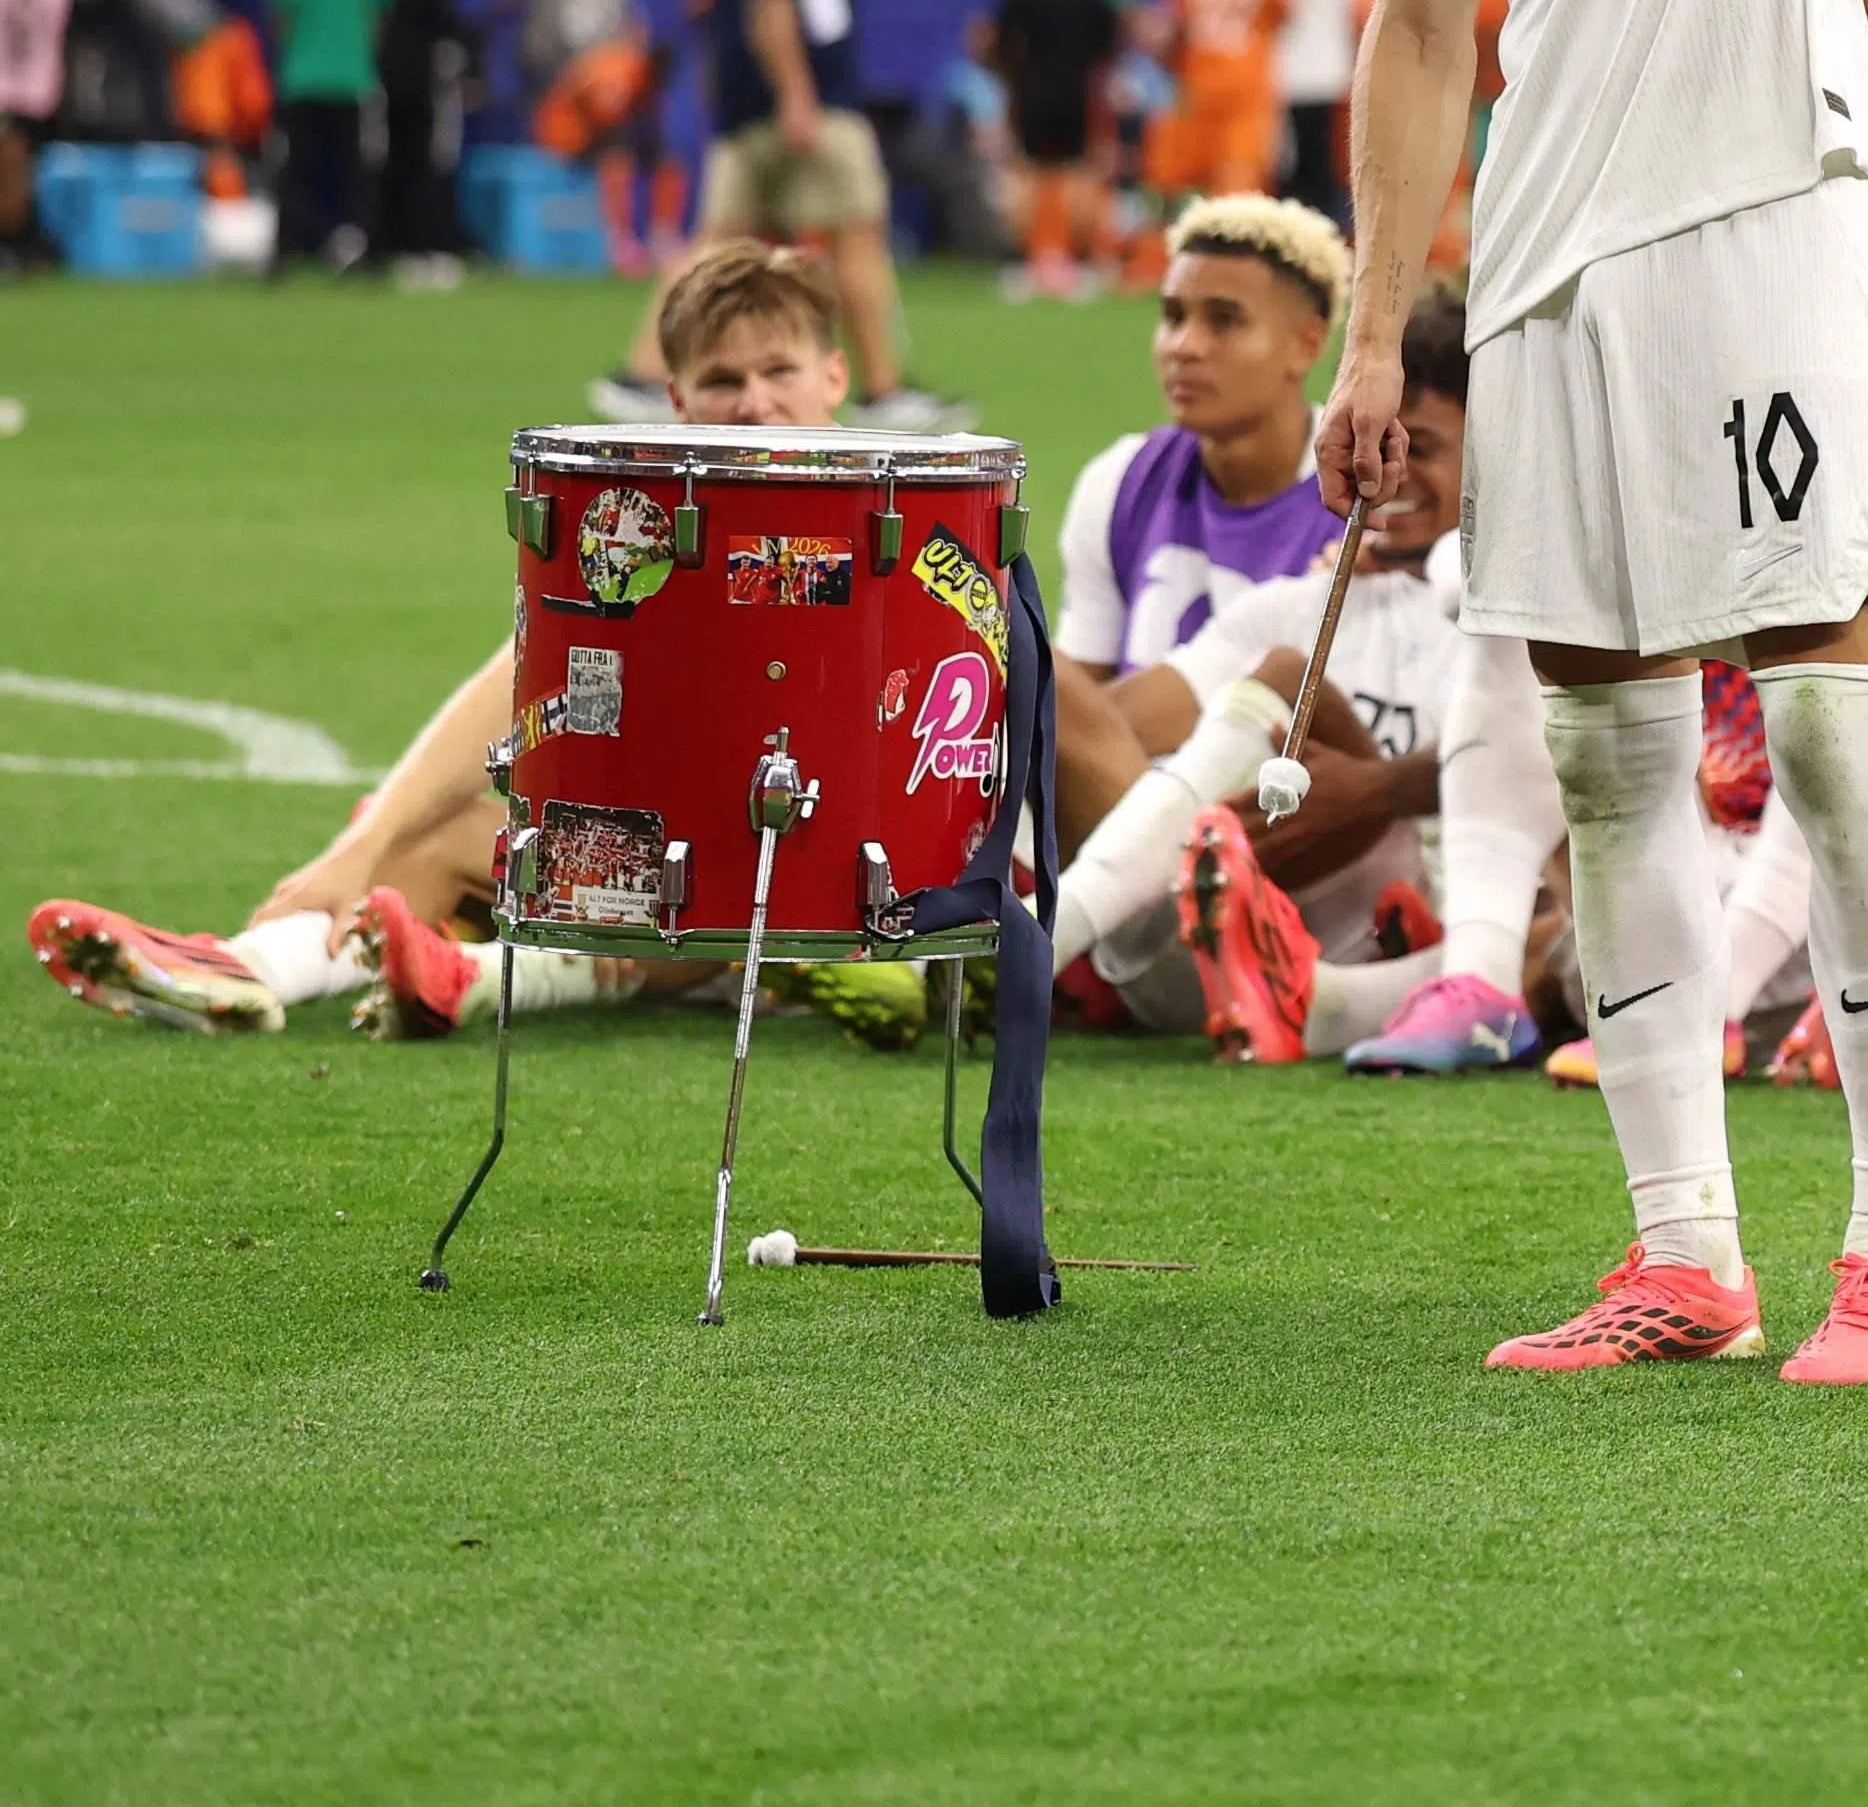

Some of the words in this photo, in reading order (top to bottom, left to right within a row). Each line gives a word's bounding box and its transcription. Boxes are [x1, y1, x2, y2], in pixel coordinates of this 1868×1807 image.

[1723, 391, 1819, 530] 10
[787, 537, 832, 556] 2026
[906, 652, 994, 795] POWER
